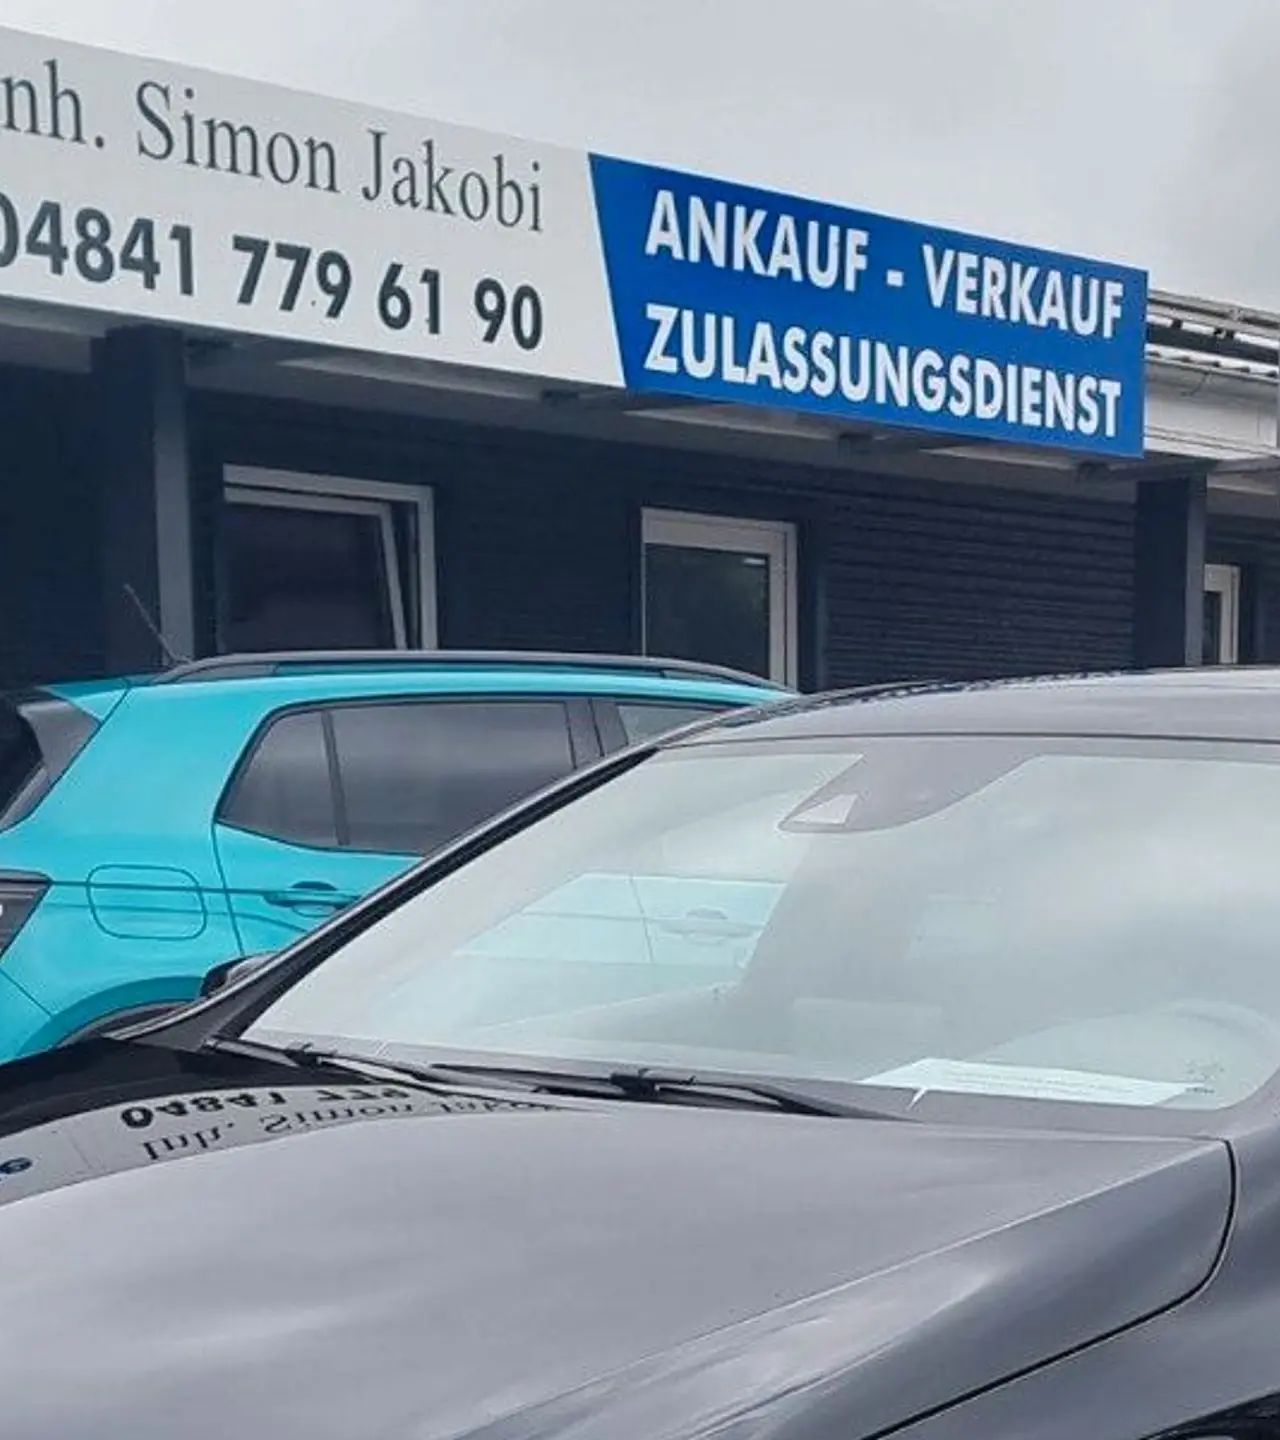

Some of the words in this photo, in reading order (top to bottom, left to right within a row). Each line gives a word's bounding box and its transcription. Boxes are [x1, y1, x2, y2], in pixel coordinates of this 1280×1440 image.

[134, 78, 340, 195] Simon
[361, 126, 544, 234] Jakobi
[230, 234, 353, 322] 779
[376, 260, 446, 336] 61
[473, 277, 545, 352] 90
[646, 189, 869, 290] ANKAUF
[922, 243, 1124, 338] VERKAUF
[645, 304, 1121, 437] ZULASSUNGSDIENST
